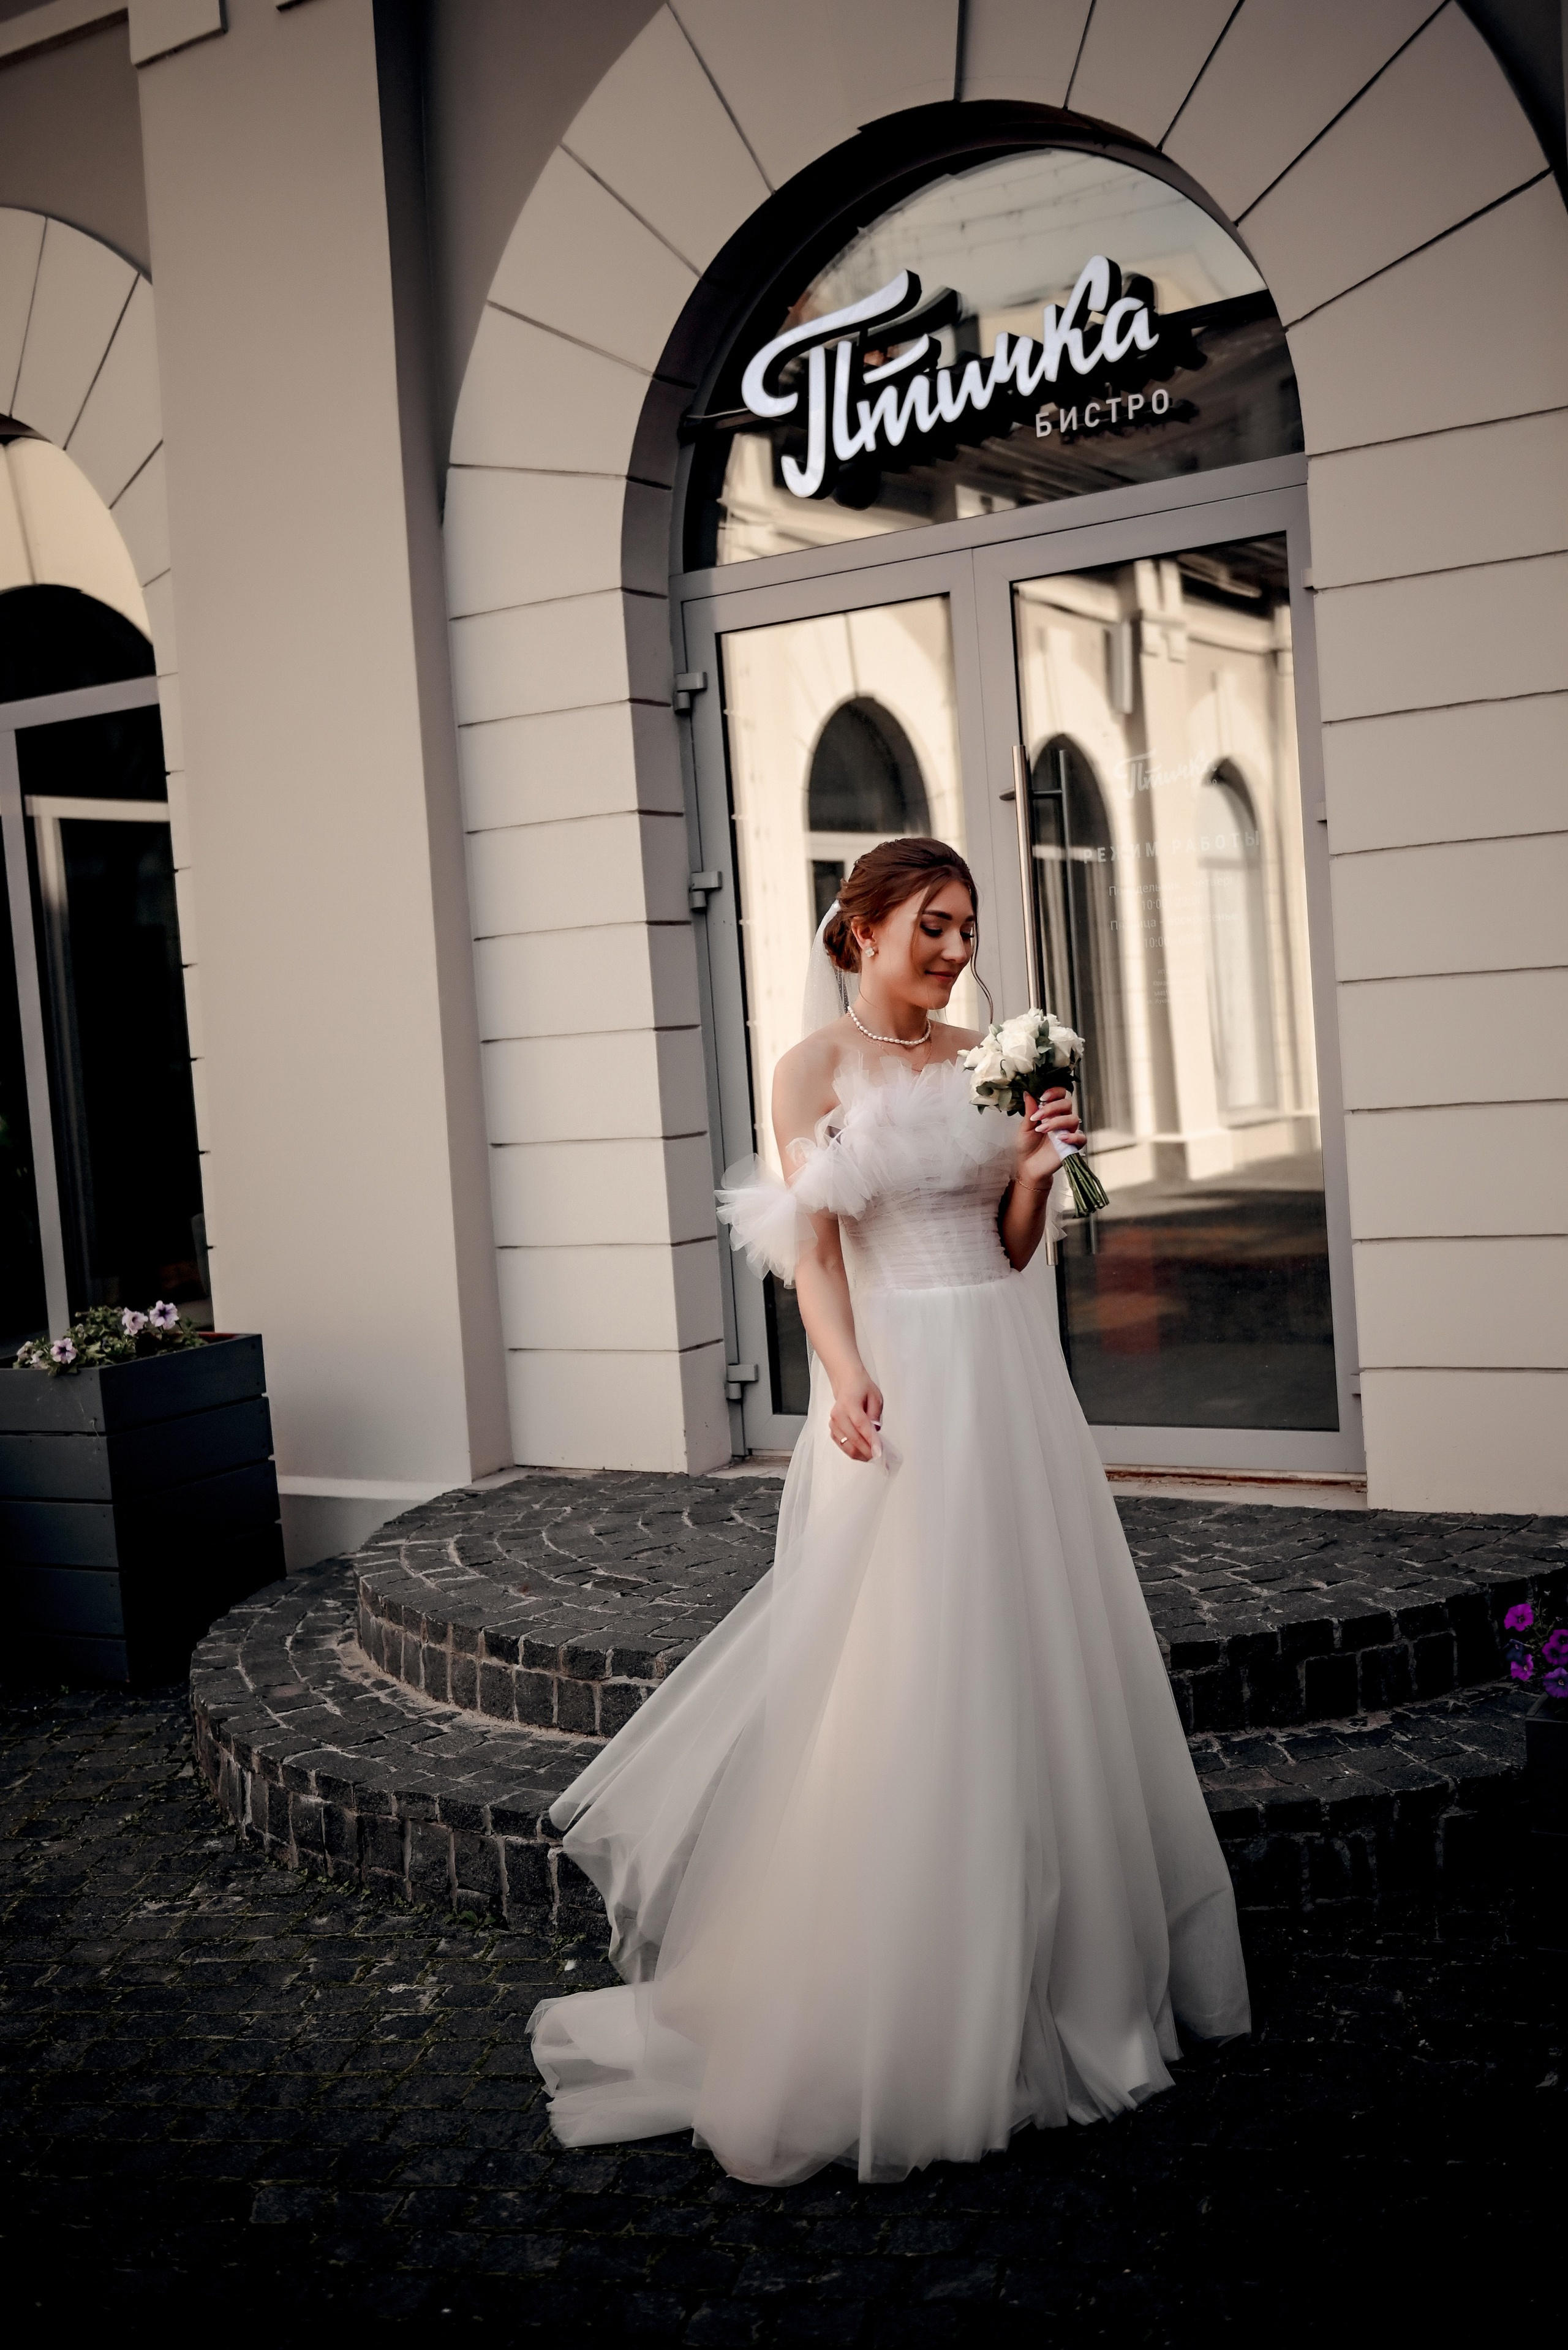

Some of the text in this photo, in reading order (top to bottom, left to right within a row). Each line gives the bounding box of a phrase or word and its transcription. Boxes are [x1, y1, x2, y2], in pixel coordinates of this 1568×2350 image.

[741, 254, 1159, 498] Птичка
[1035, 388, 1170, 438] БИСТРО
[1083, 830, 1260, 864] РЕЖИМ РАБОТЫ
[1109, 882, 1180, 897] Подельник
[1110, 919, 1156, 931] Пица
